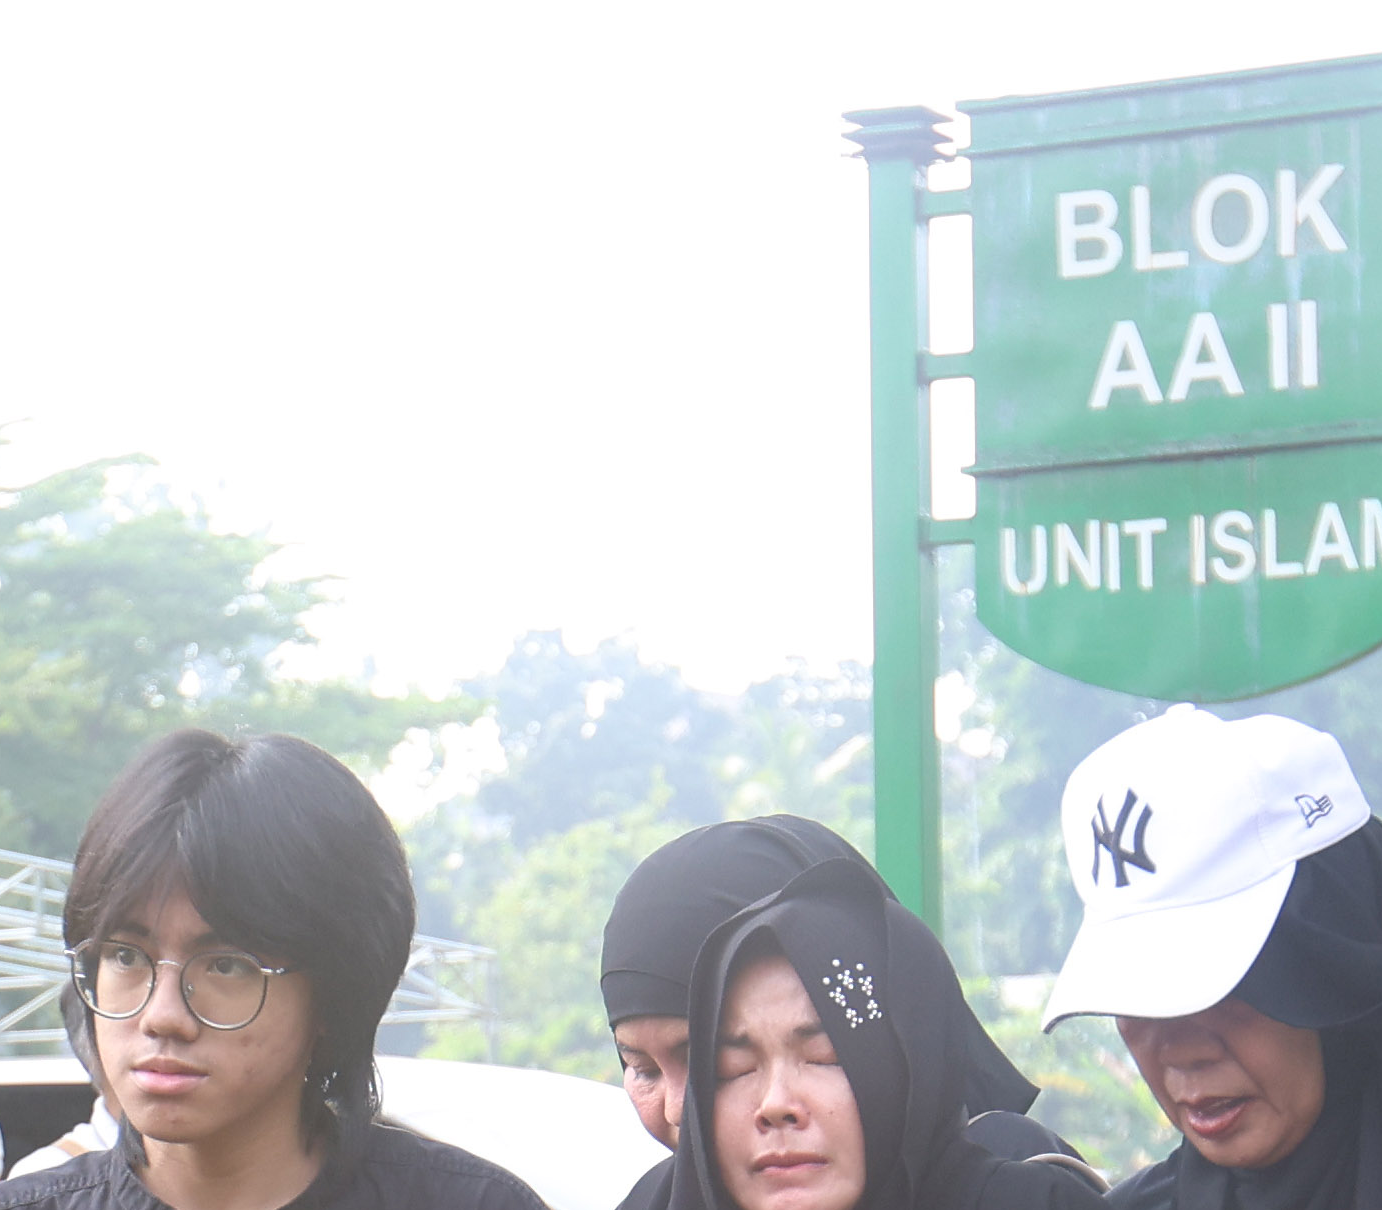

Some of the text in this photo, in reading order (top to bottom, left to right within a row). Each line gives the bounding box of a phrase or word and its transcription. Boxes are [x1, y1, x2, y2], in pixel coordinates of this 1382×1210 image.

[1057, 163, 1348, 279] BLOK
[1087, 311, 1246, 409] AA
[1001, 517, 1168, 595] UNIT
[1090, 787, 1157, 888] NY
